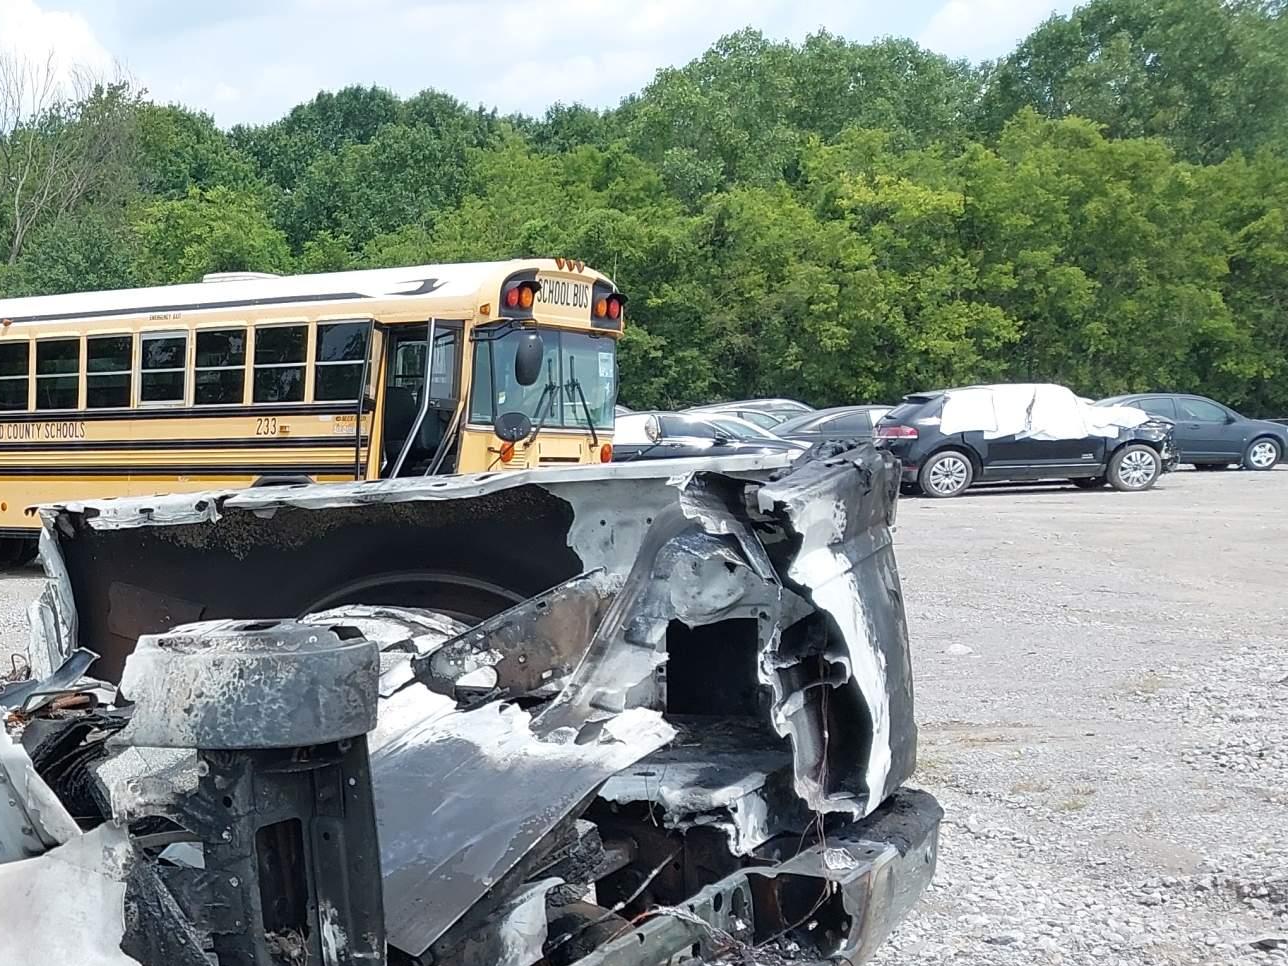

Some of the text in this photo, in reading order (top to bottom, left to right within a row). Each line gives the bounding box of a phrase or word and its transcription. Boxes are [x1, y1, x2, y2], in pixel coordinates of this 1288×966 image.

[537, 278, 589, 309] SCHOOL BUS
[7, 423, 42, 439] COUNTY
[44, 422, 85, 439] SCHOOLS
[256, 418, 277, 435] 233
